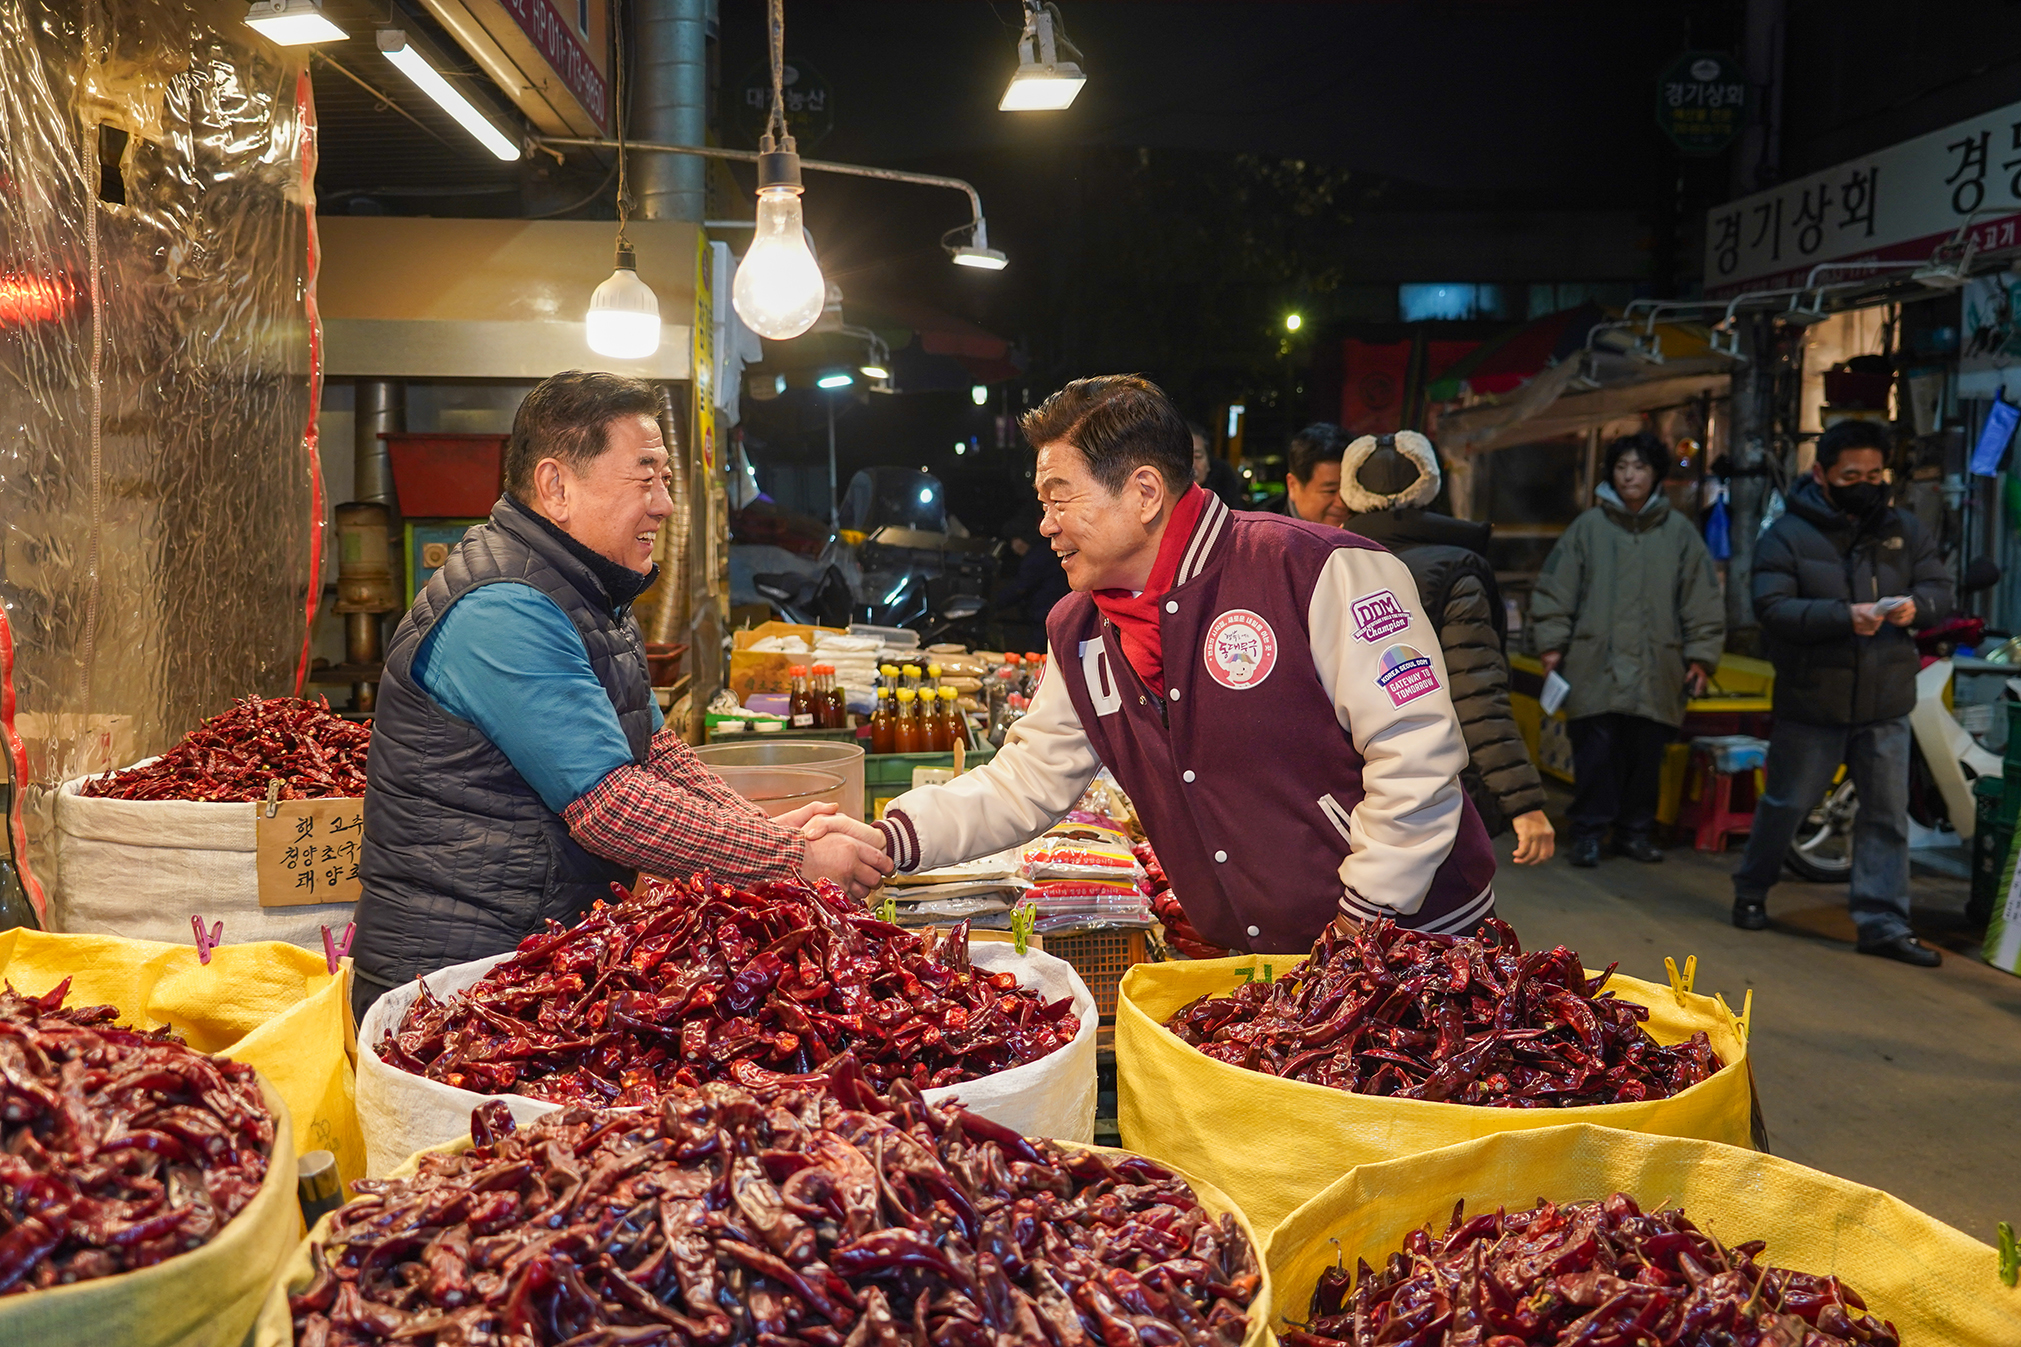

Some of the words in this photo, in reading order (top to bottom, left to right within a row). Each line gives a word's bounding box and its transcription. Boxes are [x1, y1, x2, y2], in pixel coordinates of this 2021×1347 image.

[746, 87, 826, 111] 대농산
[1664, 81, 1745, 107] 경기상회
[1714, 166, 1880, 275] 경기상회
[1358, 597, 1398, 626] DDM
[1366, 618, 1406, 638] Champion
[1218, 639, 1257, 659] 동대문구
[1079, 634, 1122, 717] D
[1381, 668, 1400, 684] KOREA
[1399, 662, 1416, 672] SEOUL
[1416, 658, 1428, 666] DDM
[1389, 672, 1421, 692] GATEWAY
[1421, 668, 1431, 678] TO
[1395, 678, 1434, 700] TOMORROW
[294, 816, 313, 844] 햇
[329, 814, 363, 836] 고추
[279, 841, 361, 869] 청양초(국
